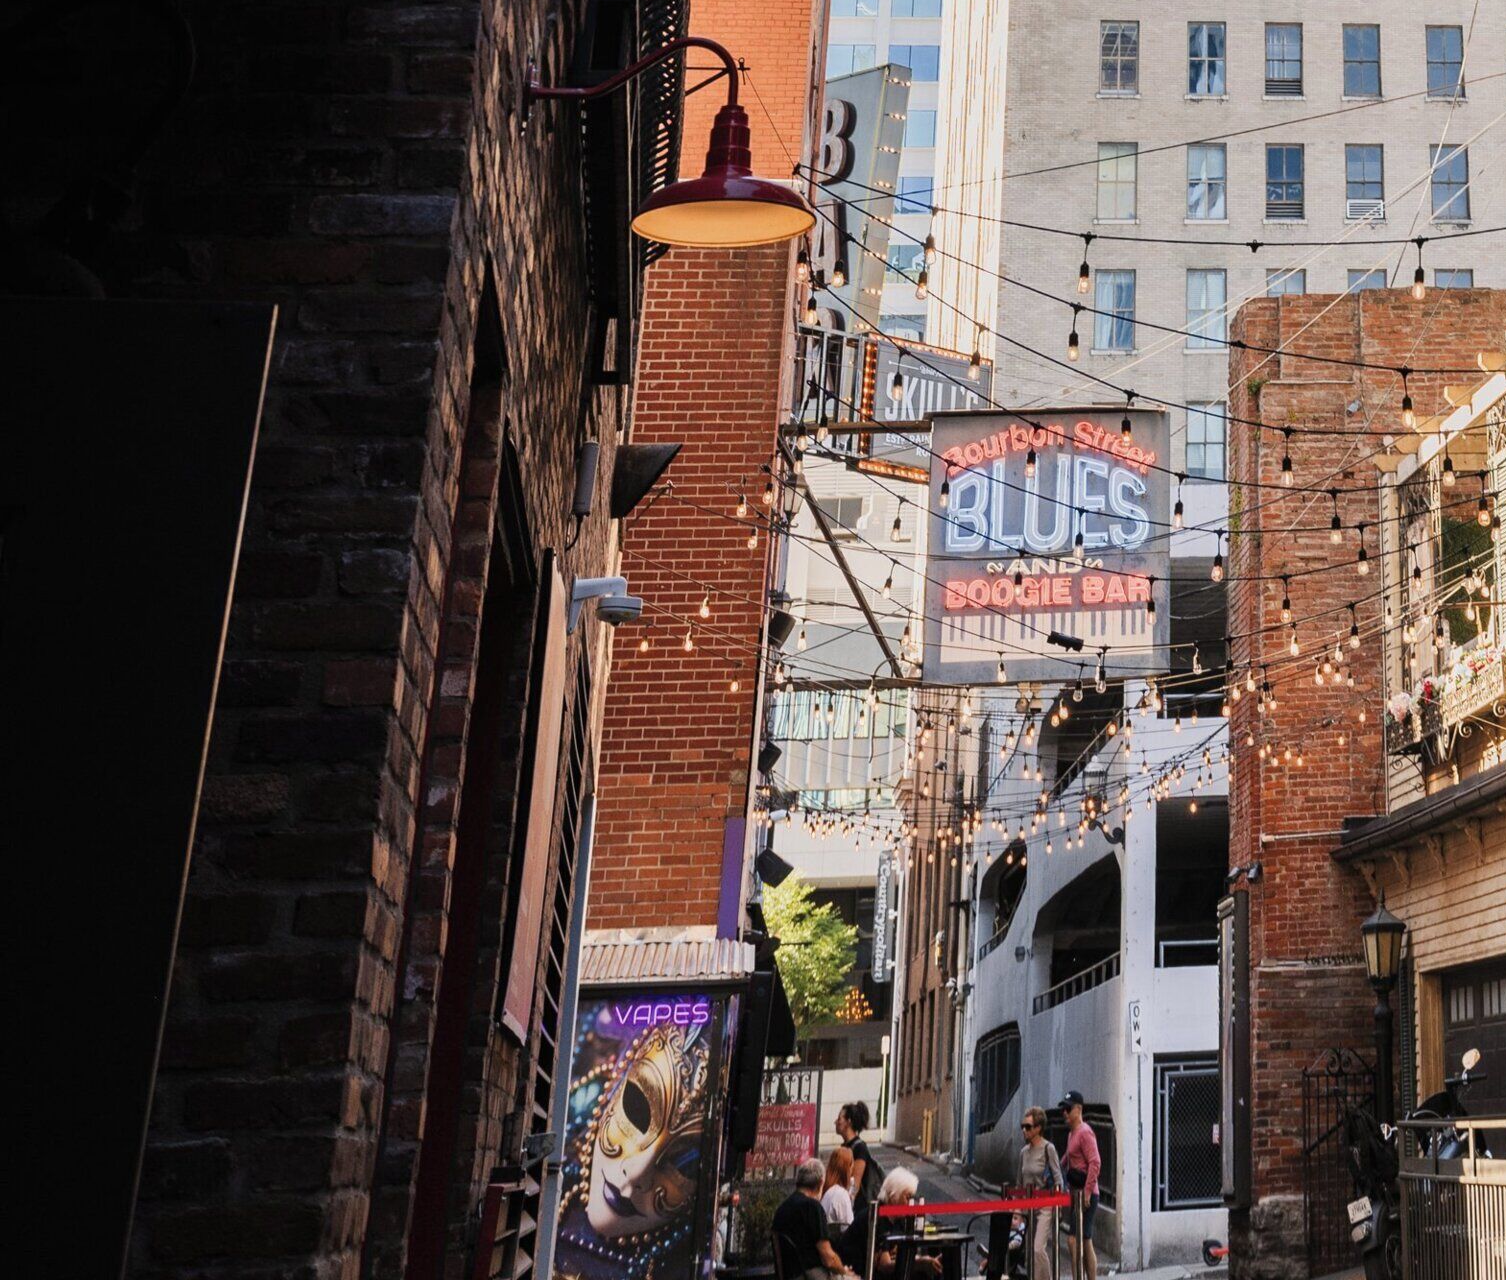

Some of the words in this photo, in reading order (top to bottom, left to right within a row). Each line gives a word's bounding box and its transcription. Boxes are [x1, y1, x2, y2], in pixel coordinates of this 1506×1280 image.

[941, 423, 1065, 476] Bourbon
[1072, 420, 1157, 475] Street
[945, 452, 1151, 553] BLUES
[1005, 556, 1084, 576] AND
[945, 576, 1073, 609] BOOGIE
[1082, 573, 1152, 605] BAR
[615, 1002, 710, 1025] VAPES
